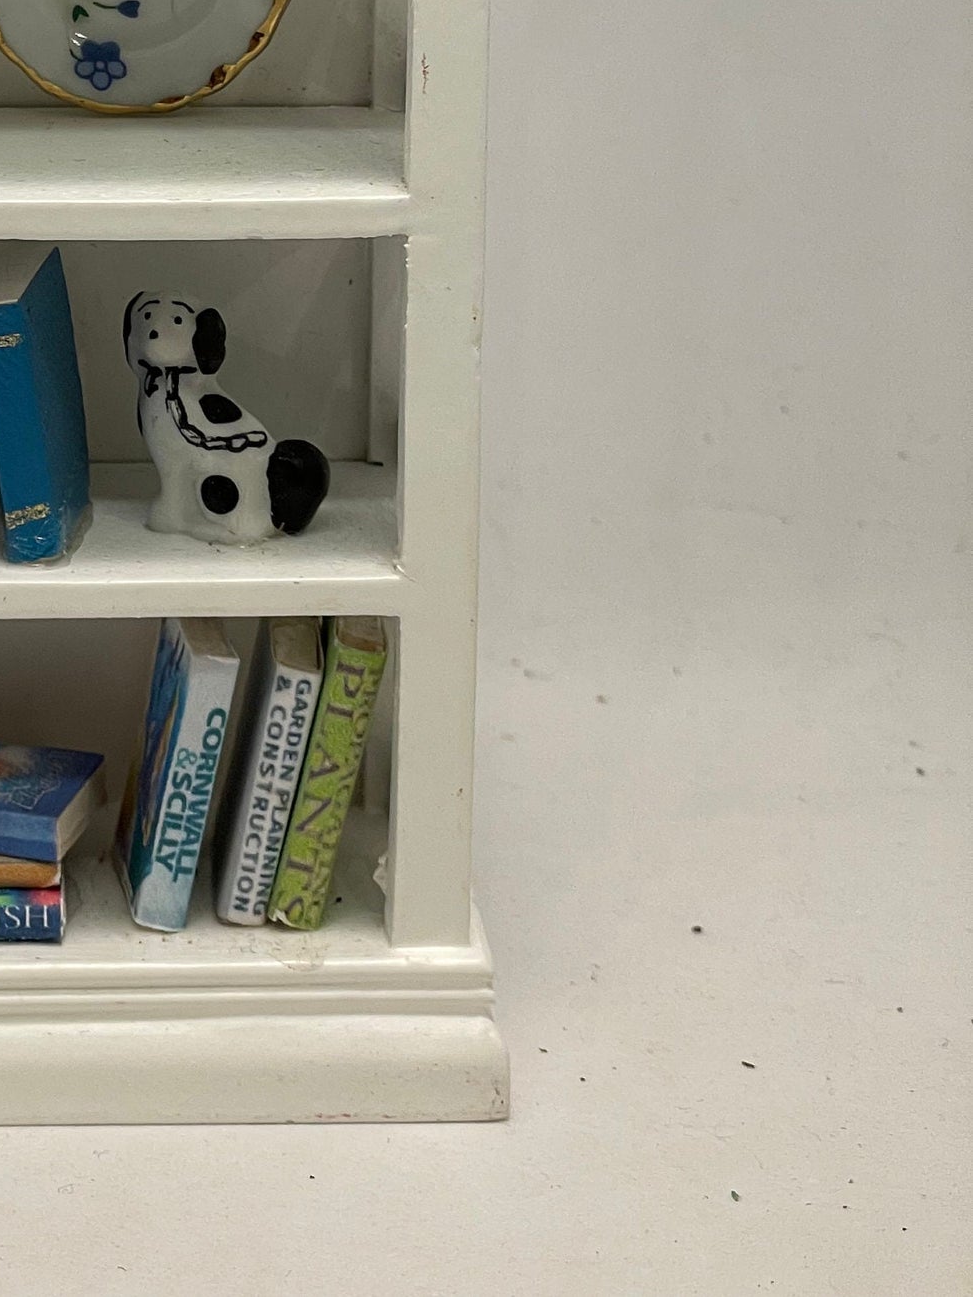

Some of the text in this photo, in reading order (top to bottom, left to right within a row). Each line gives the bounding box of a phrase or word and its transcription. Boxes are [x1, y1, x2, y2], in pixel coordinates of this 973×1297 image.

[155, 747, 197, 874] & SCILLY
[171, 707, 227, 883] CORNWALL
[232, 675, 293, 914] & CONSTRUCTION
[252, 678, 313, 916] GARDEN PLANNING
[285, 660, 367, 918] PLANTS
